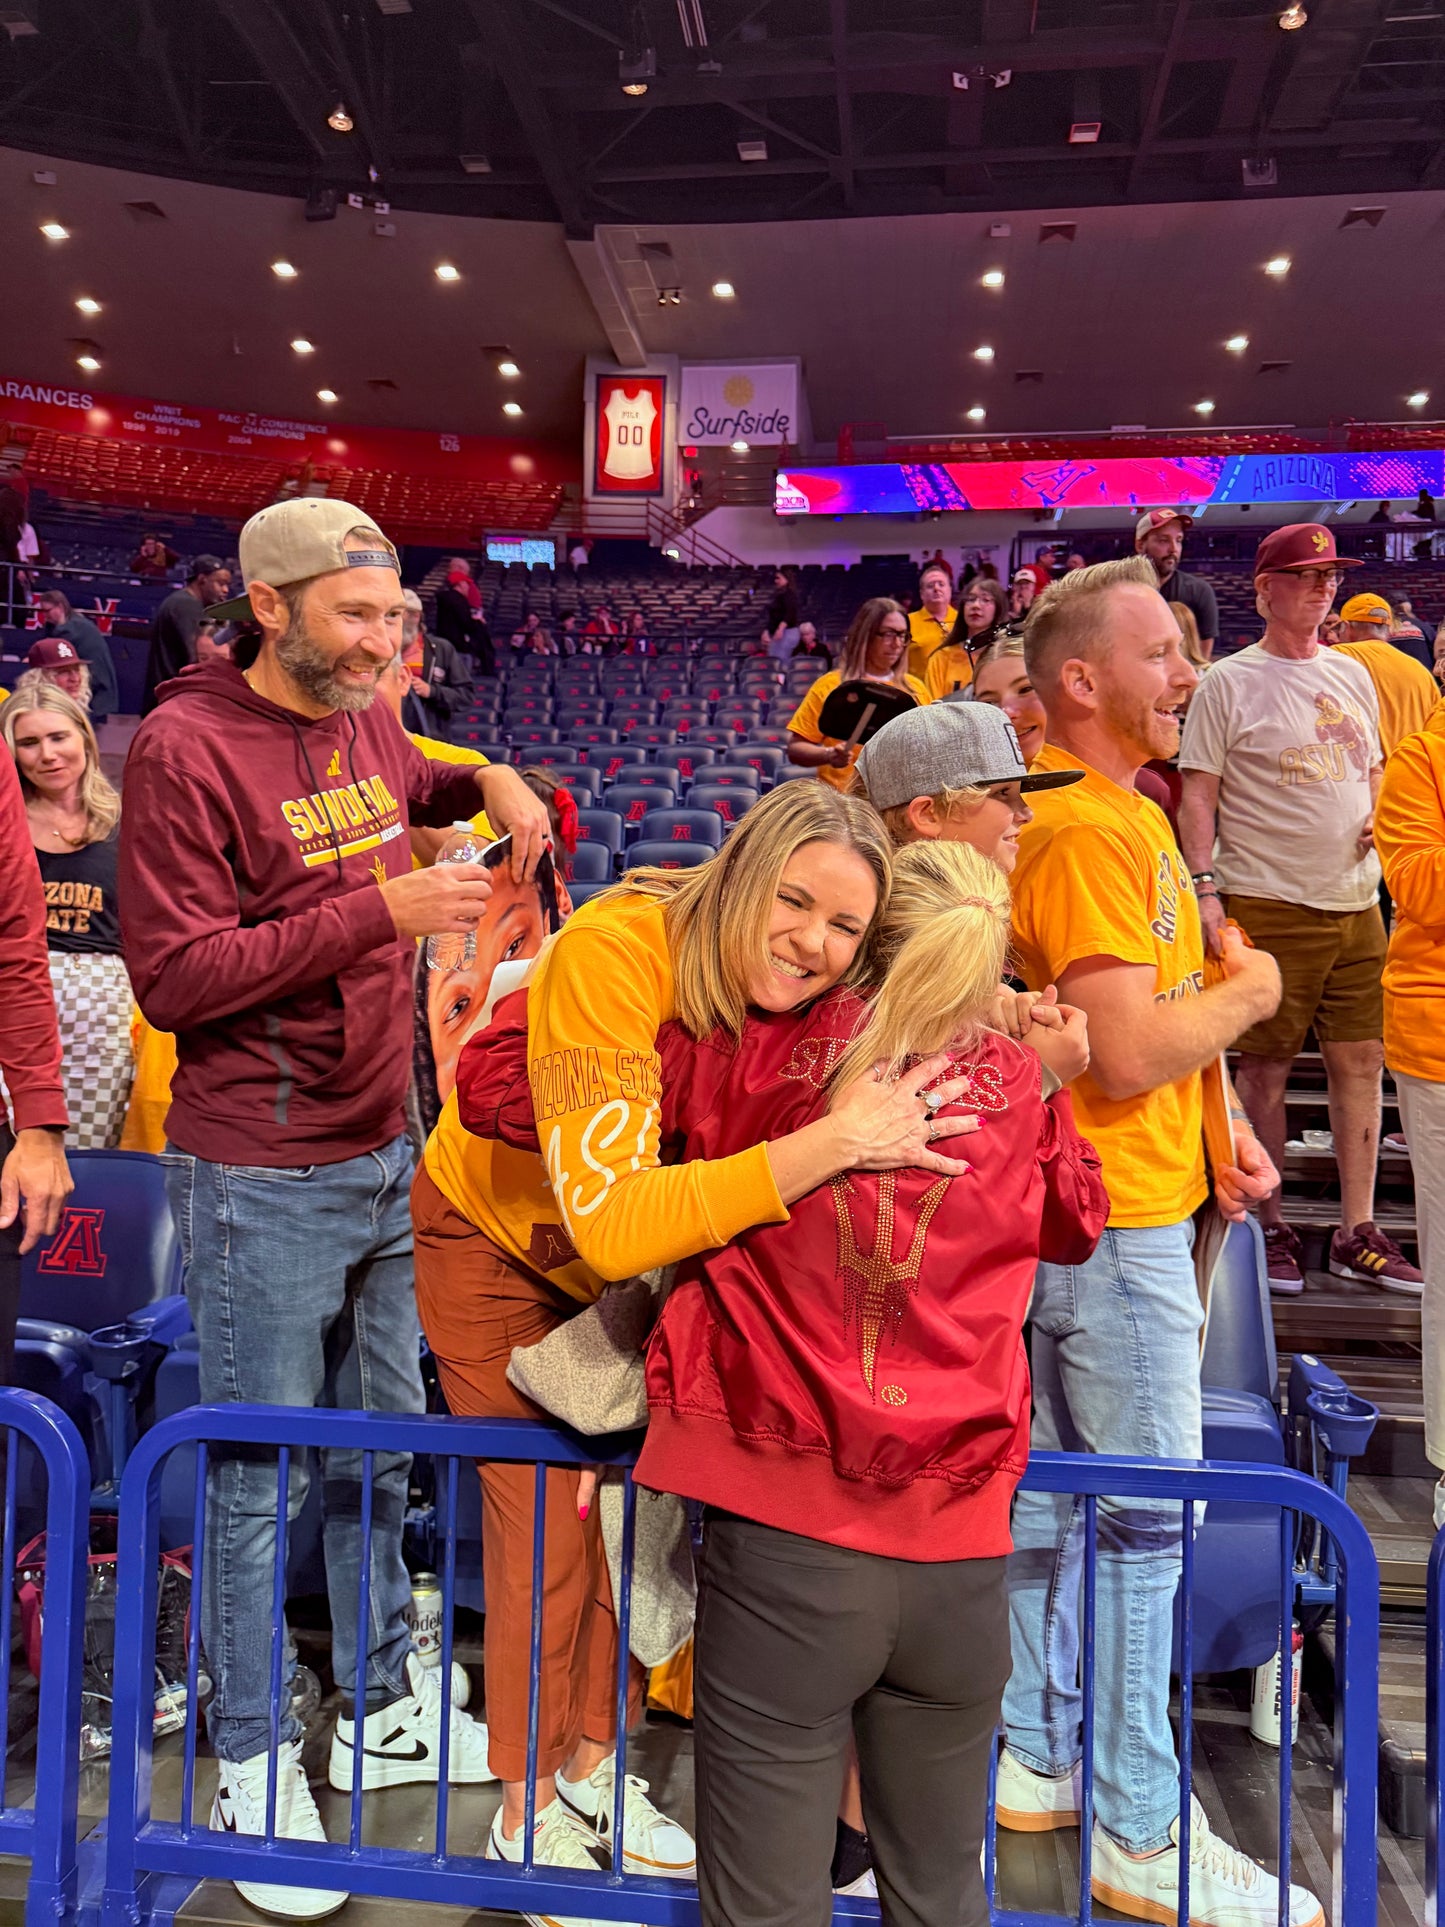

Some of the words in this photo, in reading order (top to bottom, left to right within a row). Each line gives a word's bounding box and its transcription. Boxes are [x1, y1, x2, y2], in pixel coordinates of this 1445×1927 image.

[133, 411, 201, 428] CHAMPIONS
[260, 417, 329, 434] CONFERENCE
[687, 407, 790, 438] Surfside
[154, 425, 180, 436] 2019
[227, 435, 253, 445] 2004
[241, 425, 306, 441] CHAMPIONS
[618, 425, 643, 445] 00
[1252, 456, 1337, 499] ARIZONA
[1276, 743, 1346, 787] ASU
[346, 828, 366, 839] STATE
[43, 881, 104, 913] ZONA
[46, 909, 91, 934] ATE
[37, 1206, 107, 1278] A
